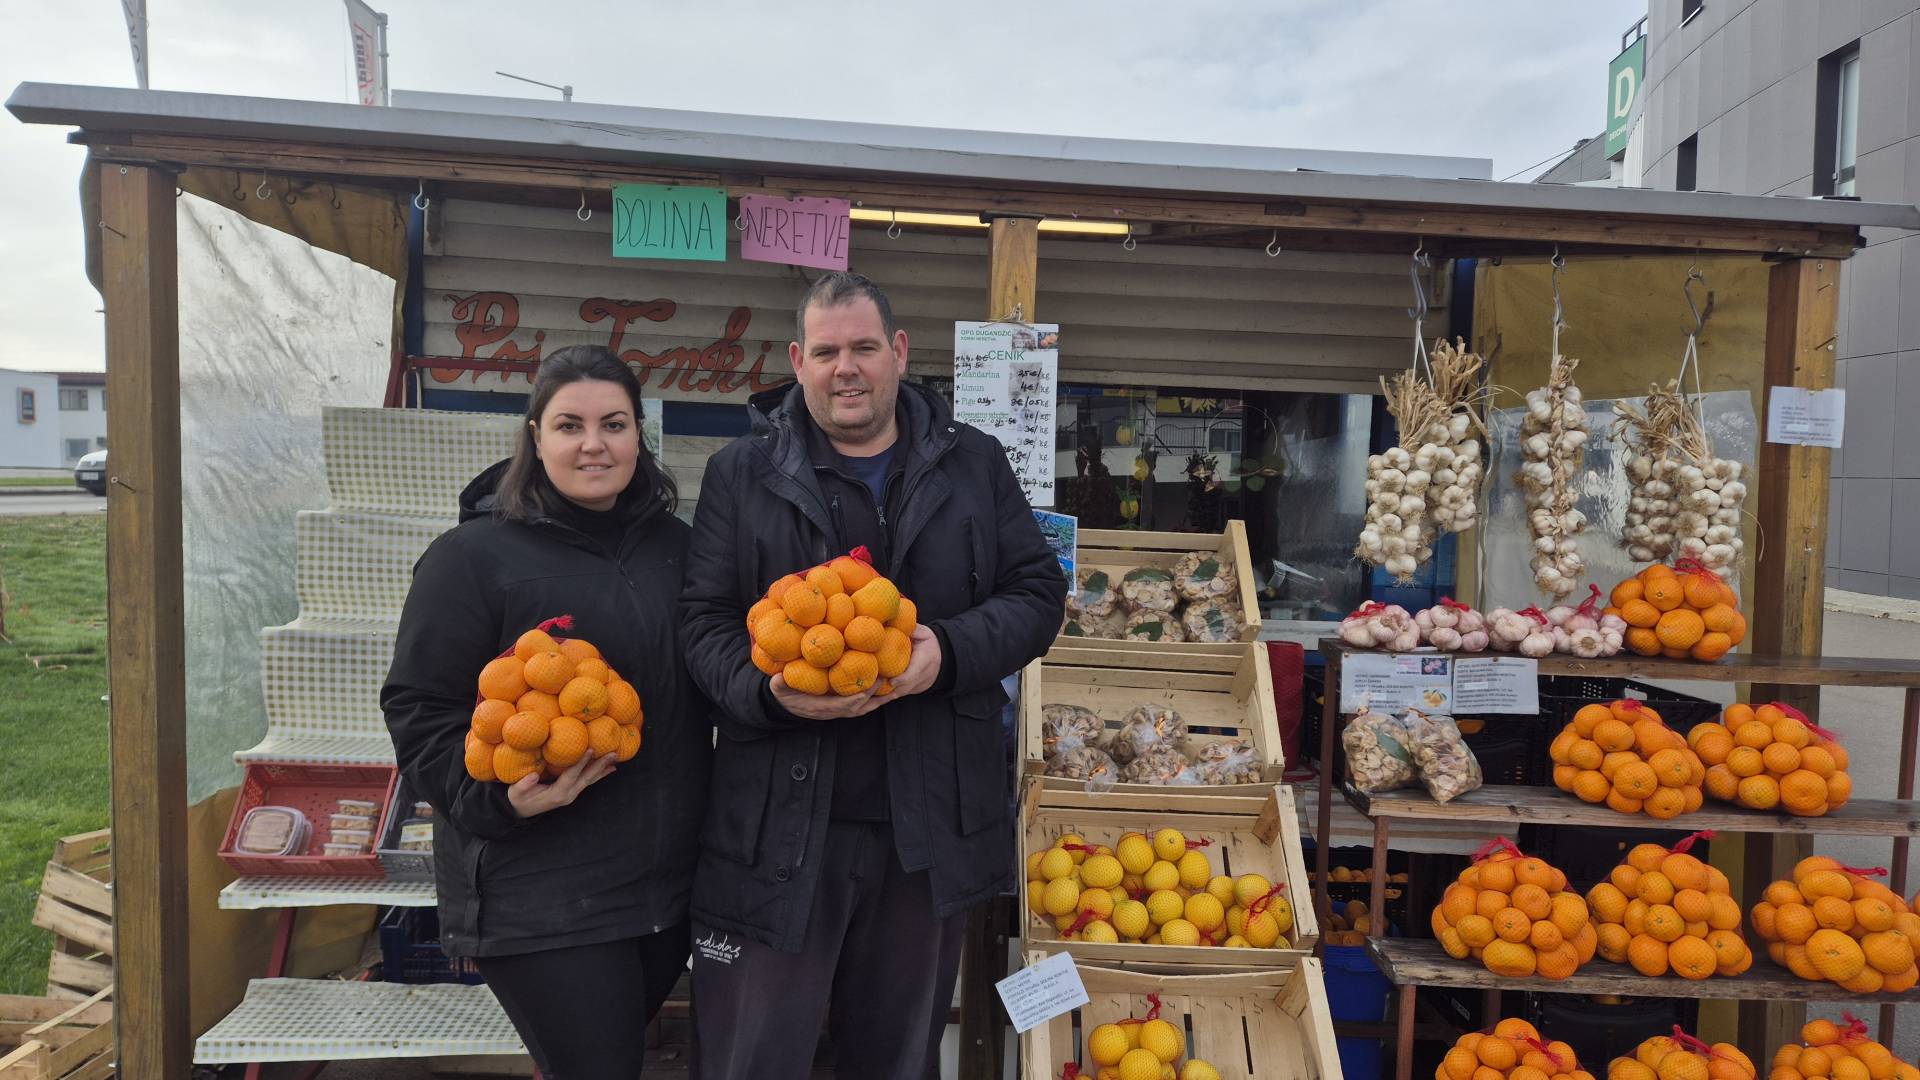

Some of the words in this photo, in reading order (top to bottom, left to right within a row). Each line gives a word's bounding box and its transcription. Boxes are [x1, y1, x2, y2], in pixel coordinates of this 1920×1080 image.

[1614, 66, 1636, 119] D
[615, 198, 714, 250] DOLINA
[744, 206, 849, 260] NERETVE
[430, 291, 546, 383] Pri
[579, 298, 798, 393] Tonki
[976, 329, 1012, 337] DUGANDŽIĆ
[988, 349, 1025, 361] CENIK
[961, 371, 1000, 379] Mandarina
[961, 383, 985, 392] Limun
[695, 931, 741, 958] adidas
